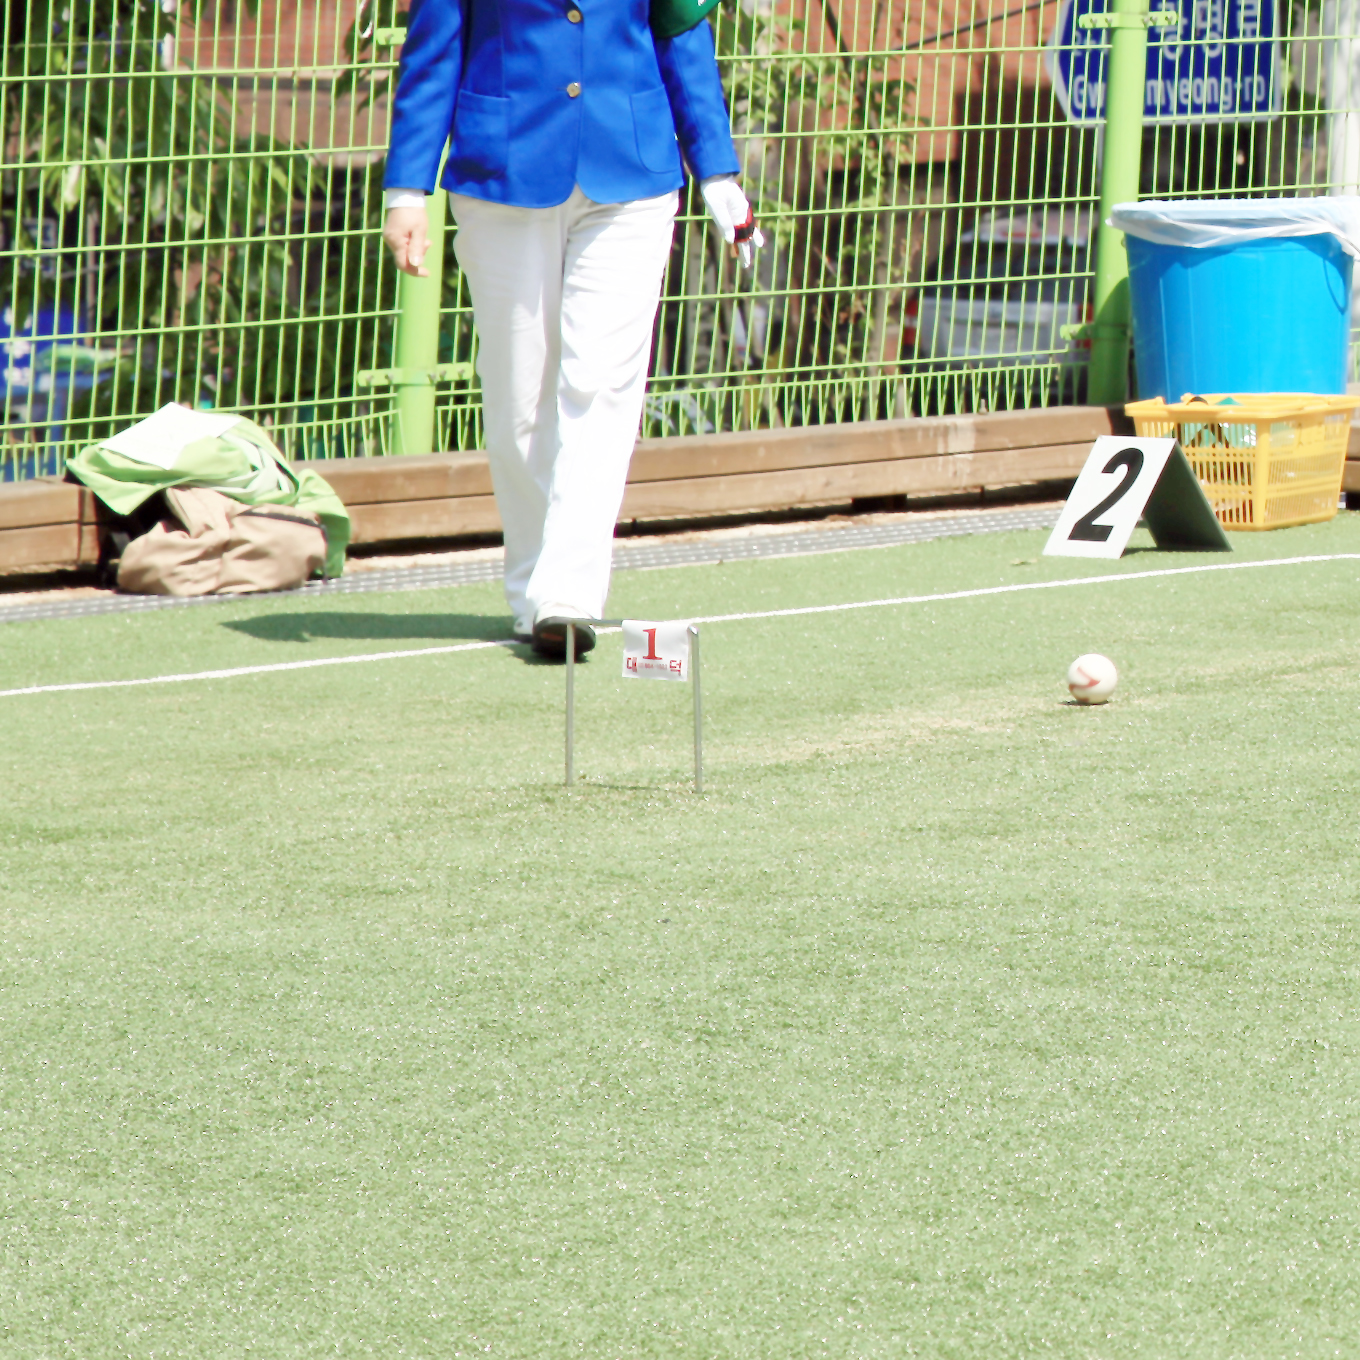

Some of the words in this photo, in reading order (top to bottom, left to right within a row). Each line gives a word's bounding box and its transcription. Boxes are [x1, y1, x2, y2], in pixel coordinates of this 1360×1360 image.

[1072, 74, 1265, 110] Gwmyeong-ro
[1067, 447, 1145, 542] 2
[643, 628, 662, 660] 1
